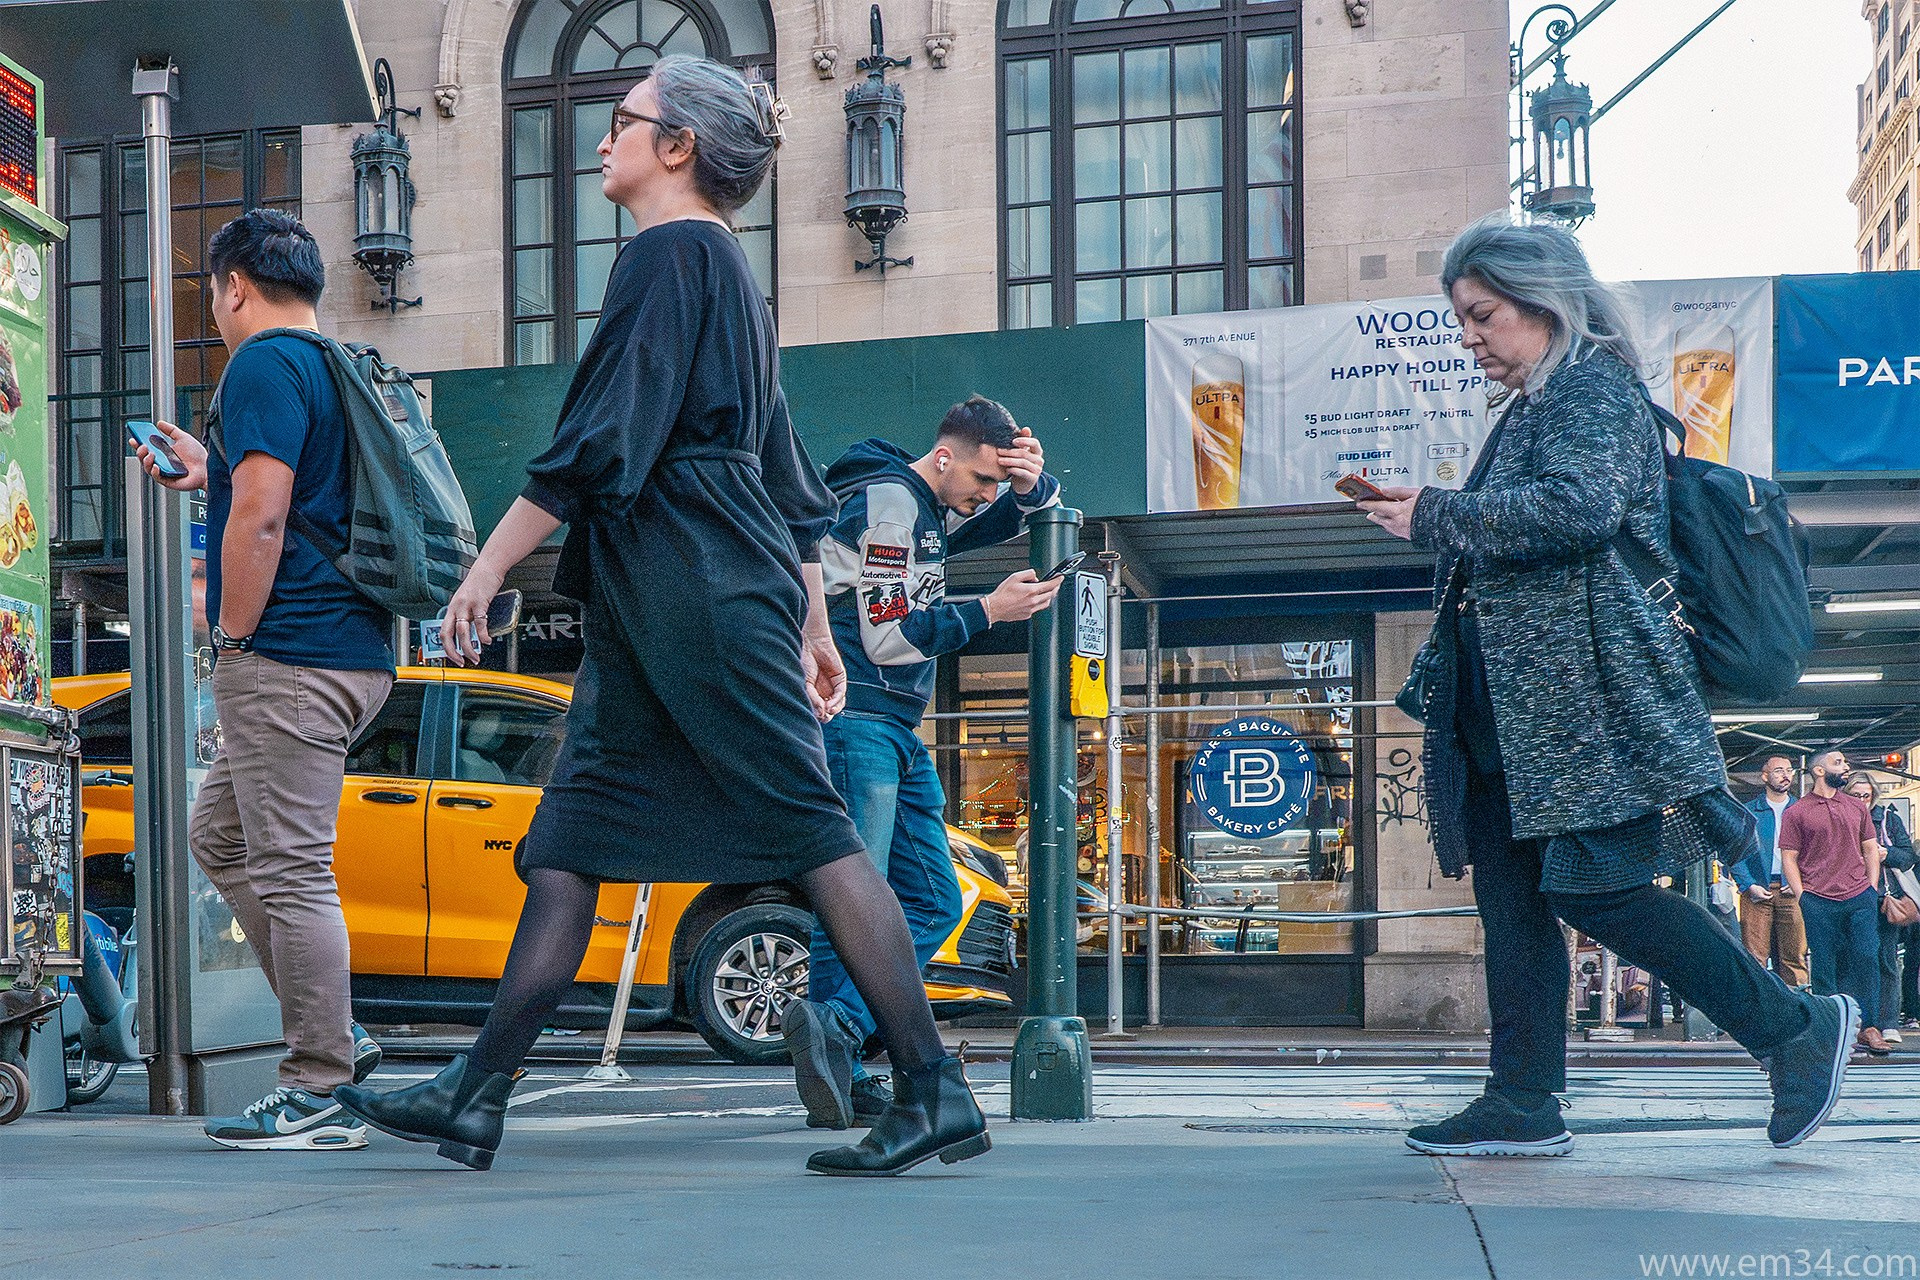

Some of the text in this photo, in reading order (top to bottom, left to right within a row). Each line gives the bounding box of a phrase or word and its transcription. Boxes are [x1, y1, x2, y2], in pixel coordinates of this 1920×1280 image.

[1671, 301, 1737, 313] @wooganyc
[1356, 309, 1459, 336] WOOG
[1183, 332, 1256, 347] 371 7th AVENUE
[1375, 332, 1463, 350] RESTAURA
[1331, 362, 1400, 381] HAPPY
[1406, 358, 1466, 375] HOUR
[1679, 361, 1730, 375] ULTRA
[1409, 378, 1452, 393] TILL
[1304, 408, 1411, 425] $5 BUD LIGHT DRAFT
[1423, 407, 1474, 422] $7 NÜTRL
[1304, 423, 1420, 439] $5 MICHELOB ULTRA DRAFT
[1337, 450, 1392, 462] BUD LIGHT
[1370, 467, 1410, 477] ULTRA
[873, 547, 903, 557] HUGO
[867, 556, 906, 567] Motorsports
[860, 569, 902, 580] Automotive
[1198, 728, 1232, 767] PARS
[1207, 803, 1302, 834] BAKERY CAFÉ
[484, 839, 513, 851] NYC
